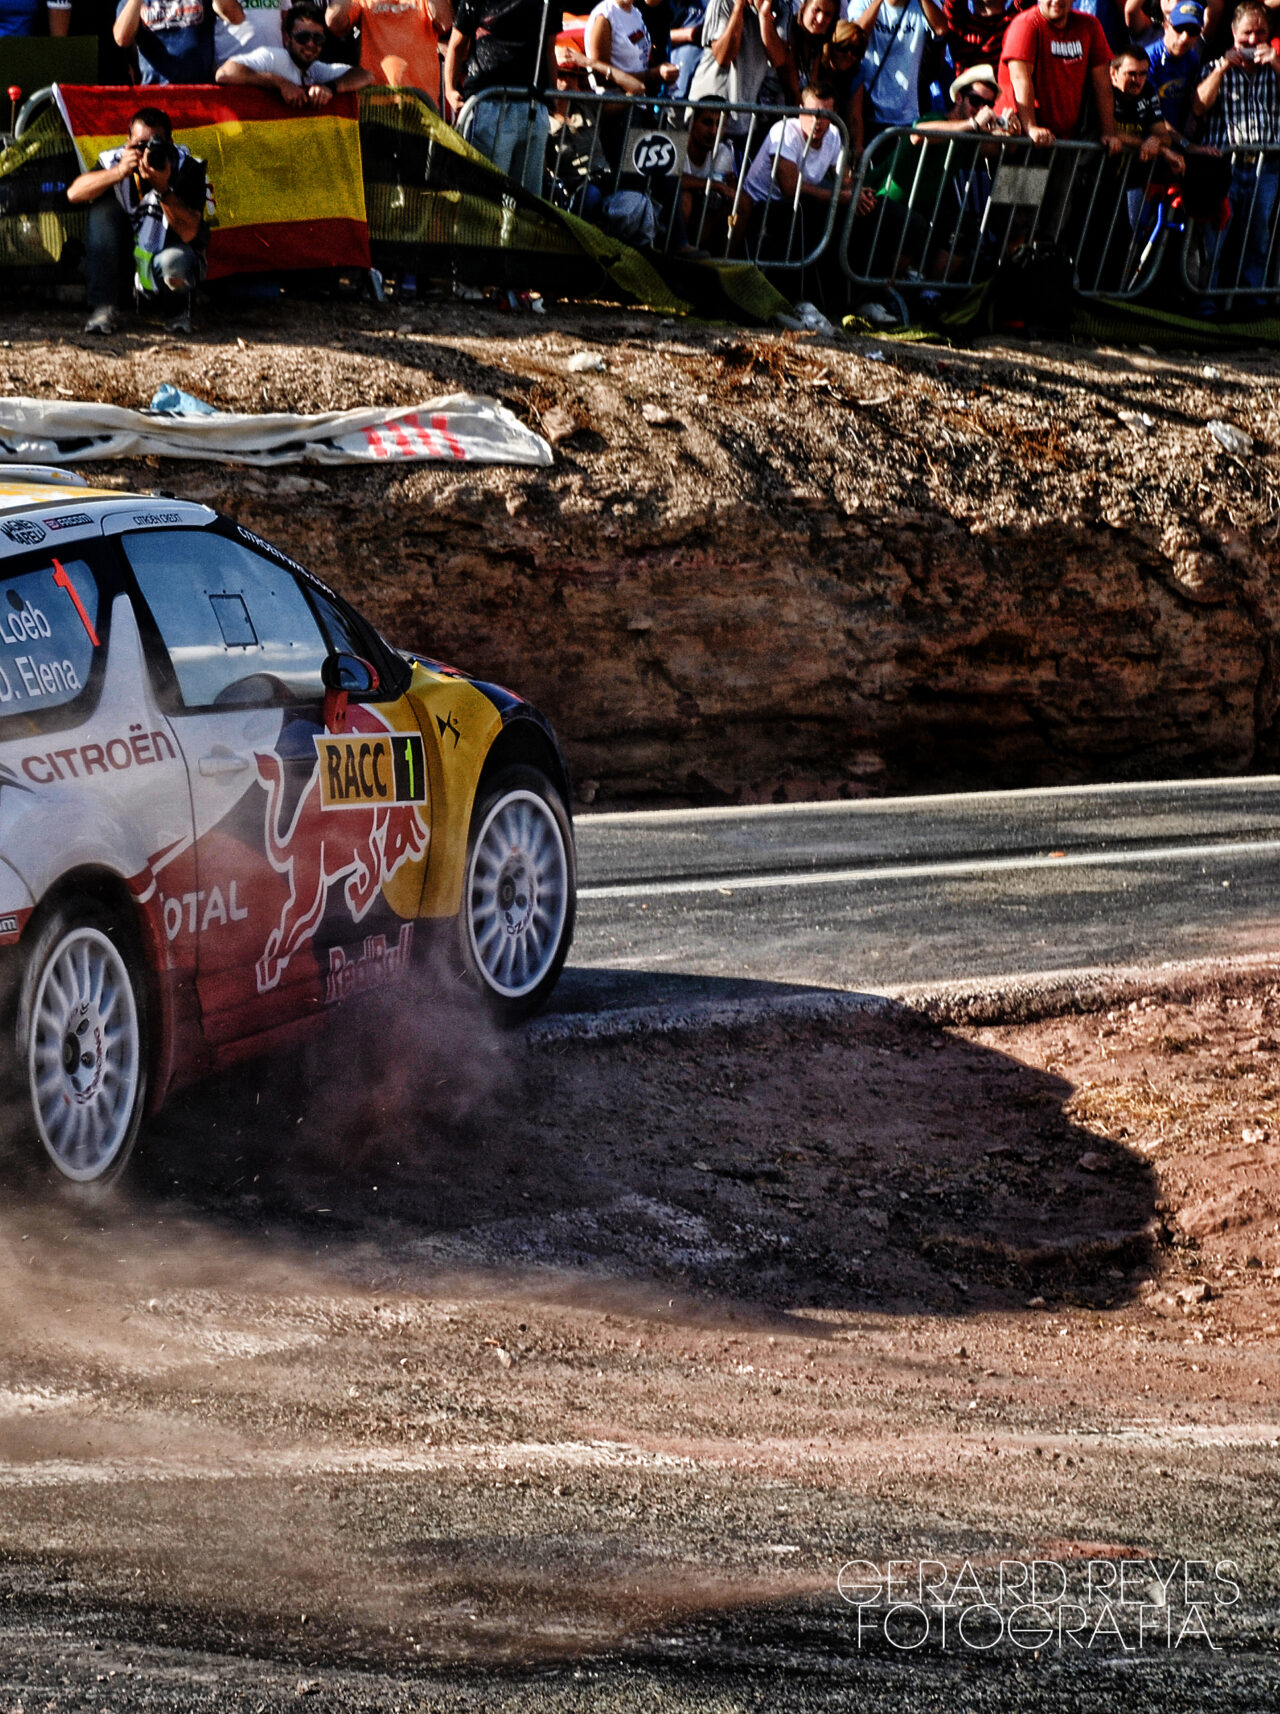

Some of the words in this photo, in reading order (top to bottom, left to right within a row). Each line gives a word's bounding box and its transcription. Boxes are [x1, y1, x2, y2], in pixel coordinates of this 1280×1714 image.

[14, 655, 82, 697] Elena
[21, 723, 177, 784] CITROËN
[326, 742, 387, 799] RACC
[404, 738, 415, 798] 1
[159, 880, 248, 941] OTAL
